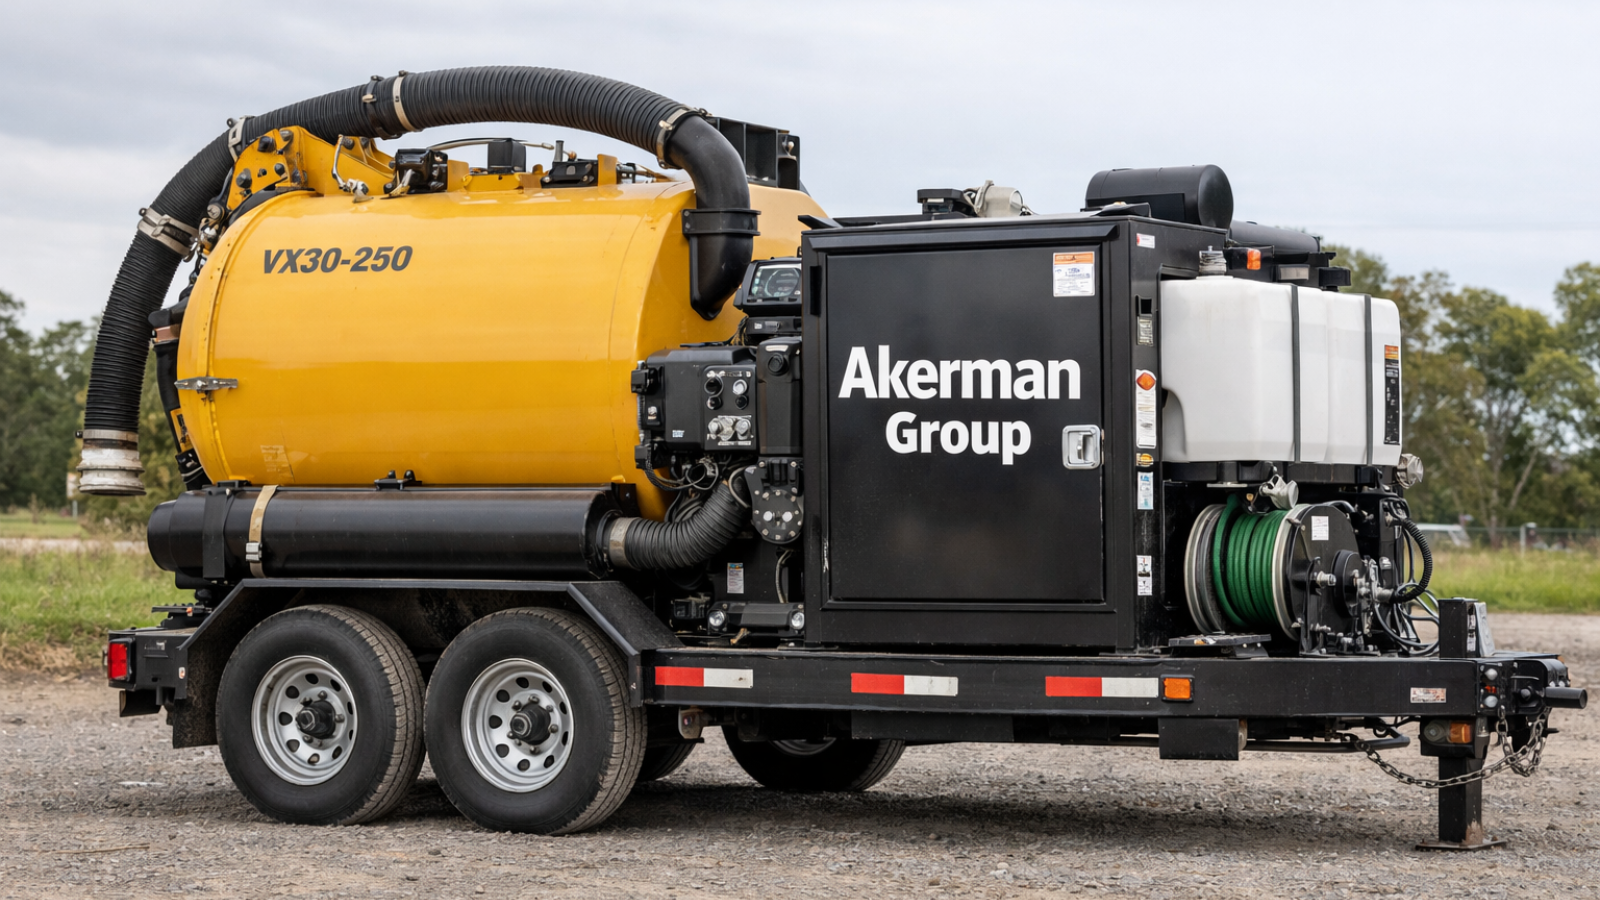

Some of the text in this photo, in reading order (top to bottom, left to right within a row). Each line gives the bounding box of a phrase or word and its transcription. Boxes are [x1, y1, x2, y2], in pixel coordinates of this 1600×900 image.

[264, 246, 413, 274] VX30-250
[838, 345, 1081, 400] Akerman
[885, 411, 1032, 465] Group
